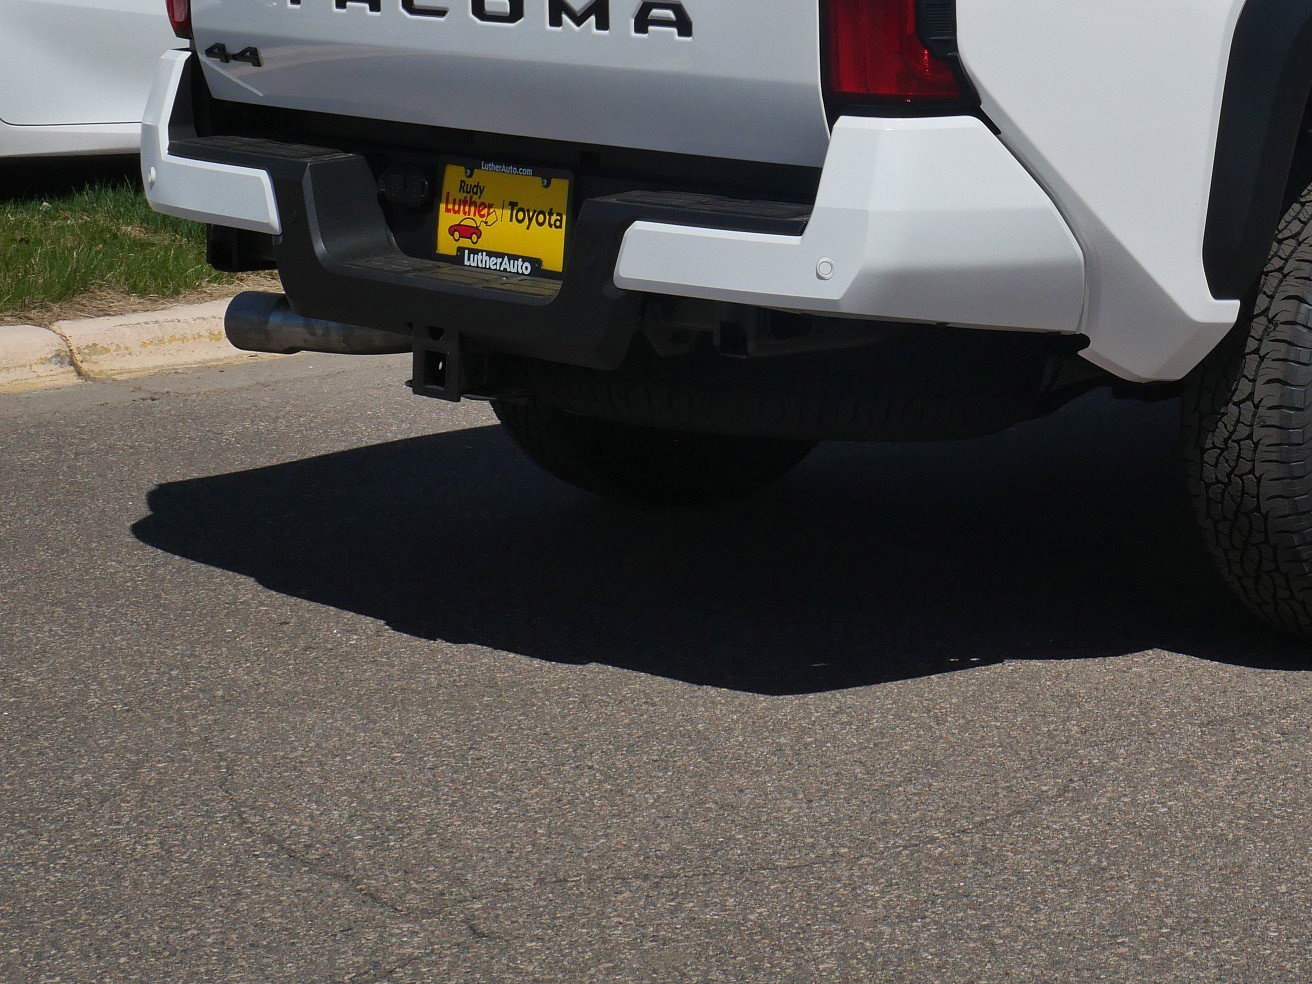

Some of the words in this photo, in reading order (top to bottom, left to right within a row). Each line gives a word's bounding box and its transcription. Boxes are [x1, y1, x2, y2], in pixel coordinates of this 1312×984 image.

[481, 161, 533, 176] LutherAuto.com
[458, 179, 485, 199] Rudy
[444, 192, 494, 219] Luther
[508, 200, 563, 230] Toyota
[463, 250, 531, 275] LutherAuto
